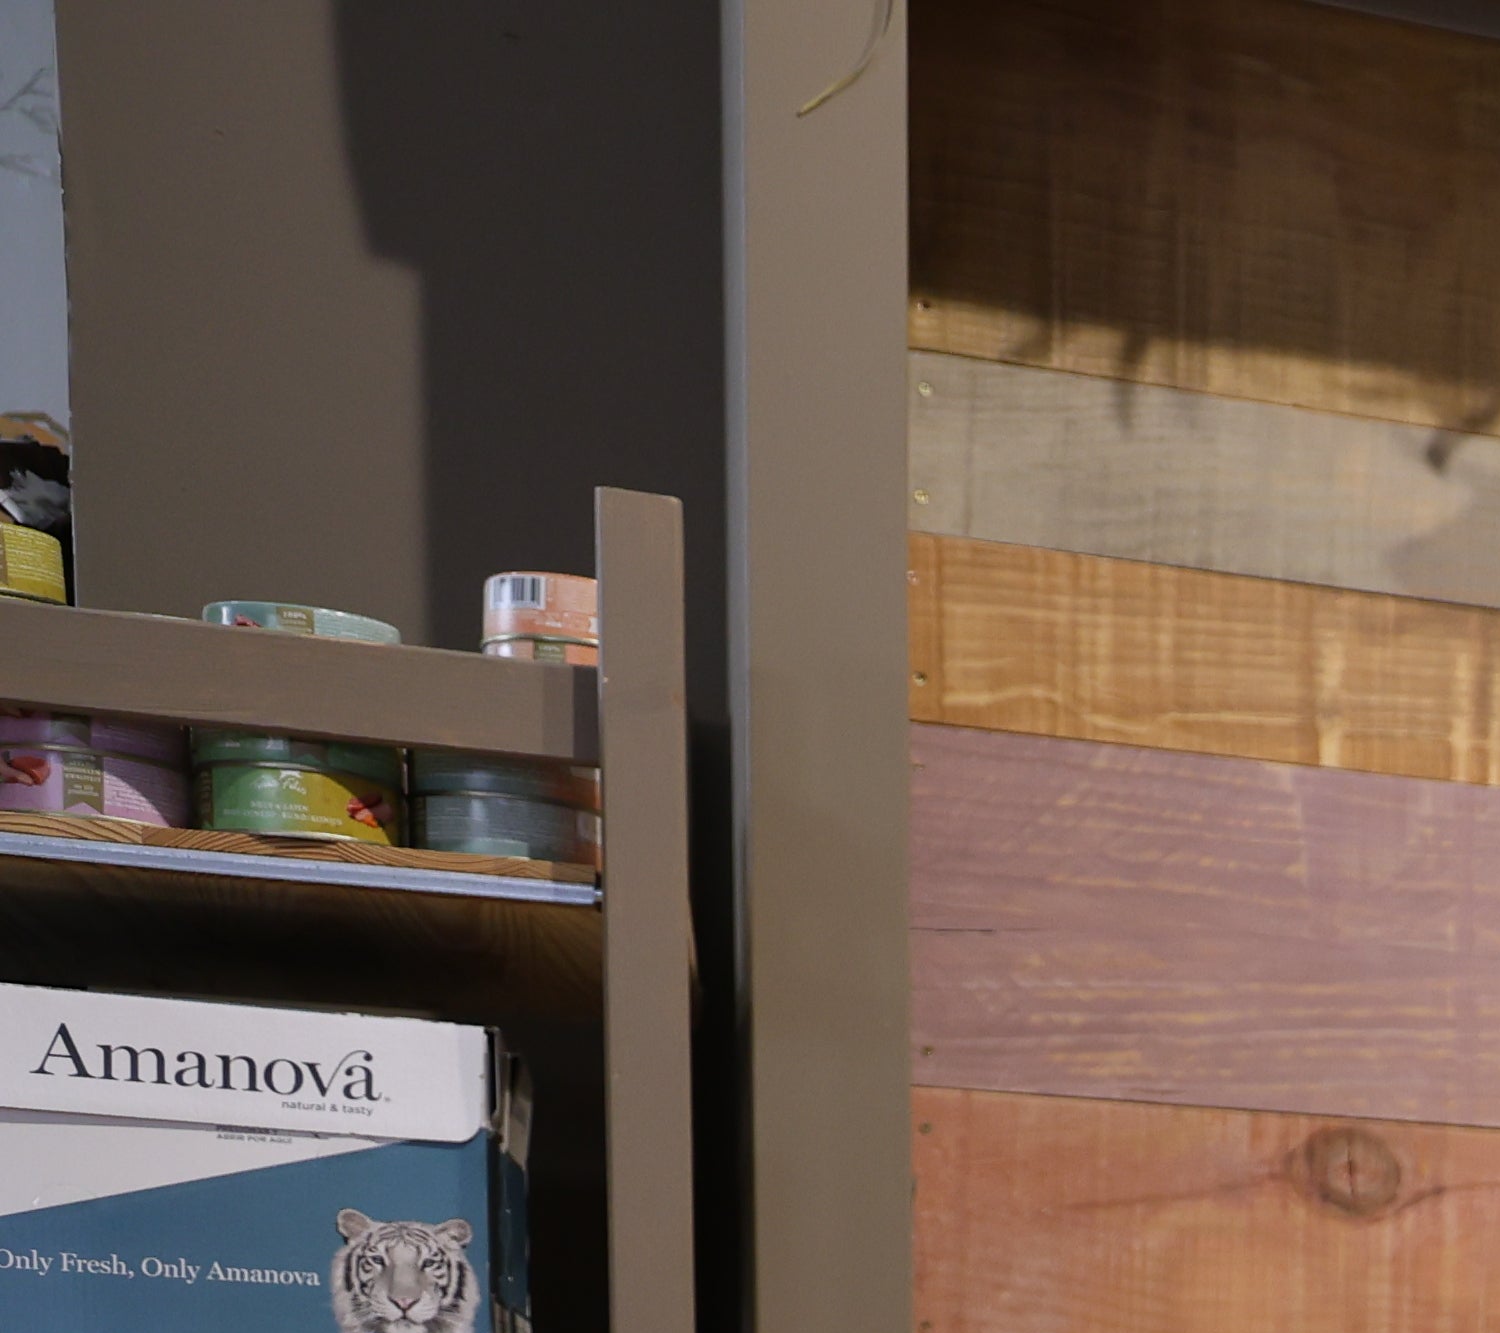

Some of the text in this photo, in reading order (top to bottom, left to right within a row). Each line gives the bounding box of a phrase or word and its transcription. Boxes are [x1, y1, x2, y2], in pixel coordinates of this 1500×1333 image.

[281, 1100, 374, 1117] natural & tasty
[0, 1248, 321, 1287] Only Fresh, Only Amanova
